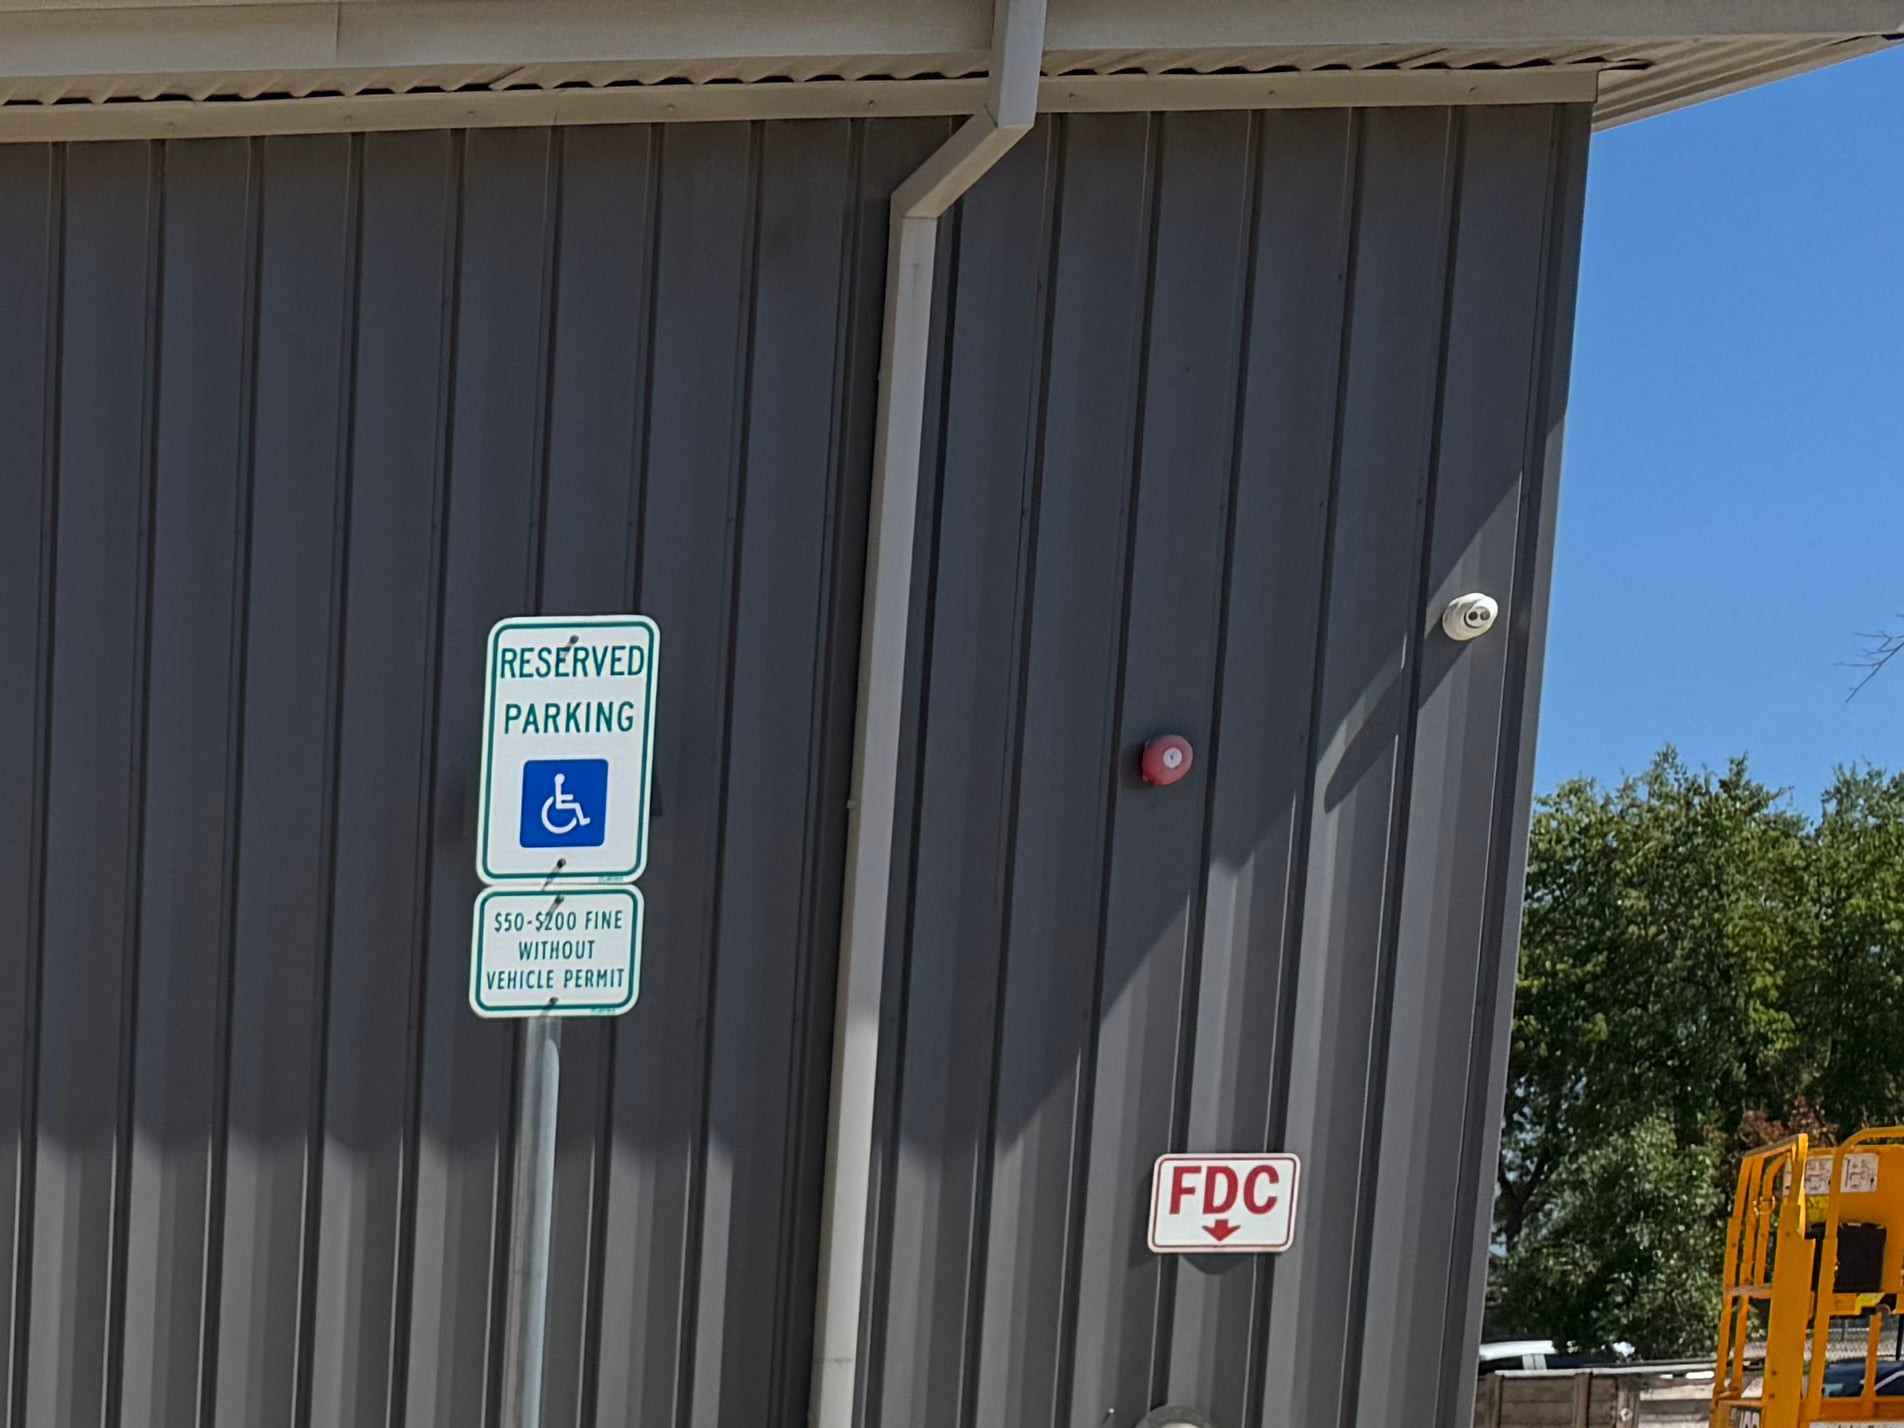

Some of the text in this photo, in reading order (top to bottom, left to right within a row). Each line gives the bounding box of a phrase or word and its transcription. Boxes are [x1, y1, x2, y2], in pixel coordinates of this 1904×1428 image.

[500, 645, 645, 679] RESERVED
[504, 701, 635, 735] PARKING
[494, 910, 623, 933] $50-$200 FINE
[518, 940, 596, 961] WITHOUT
[486, 967, 625, 990] VEHICLE PERMIT
[1169, 1165, 1280, 1215] FDC
